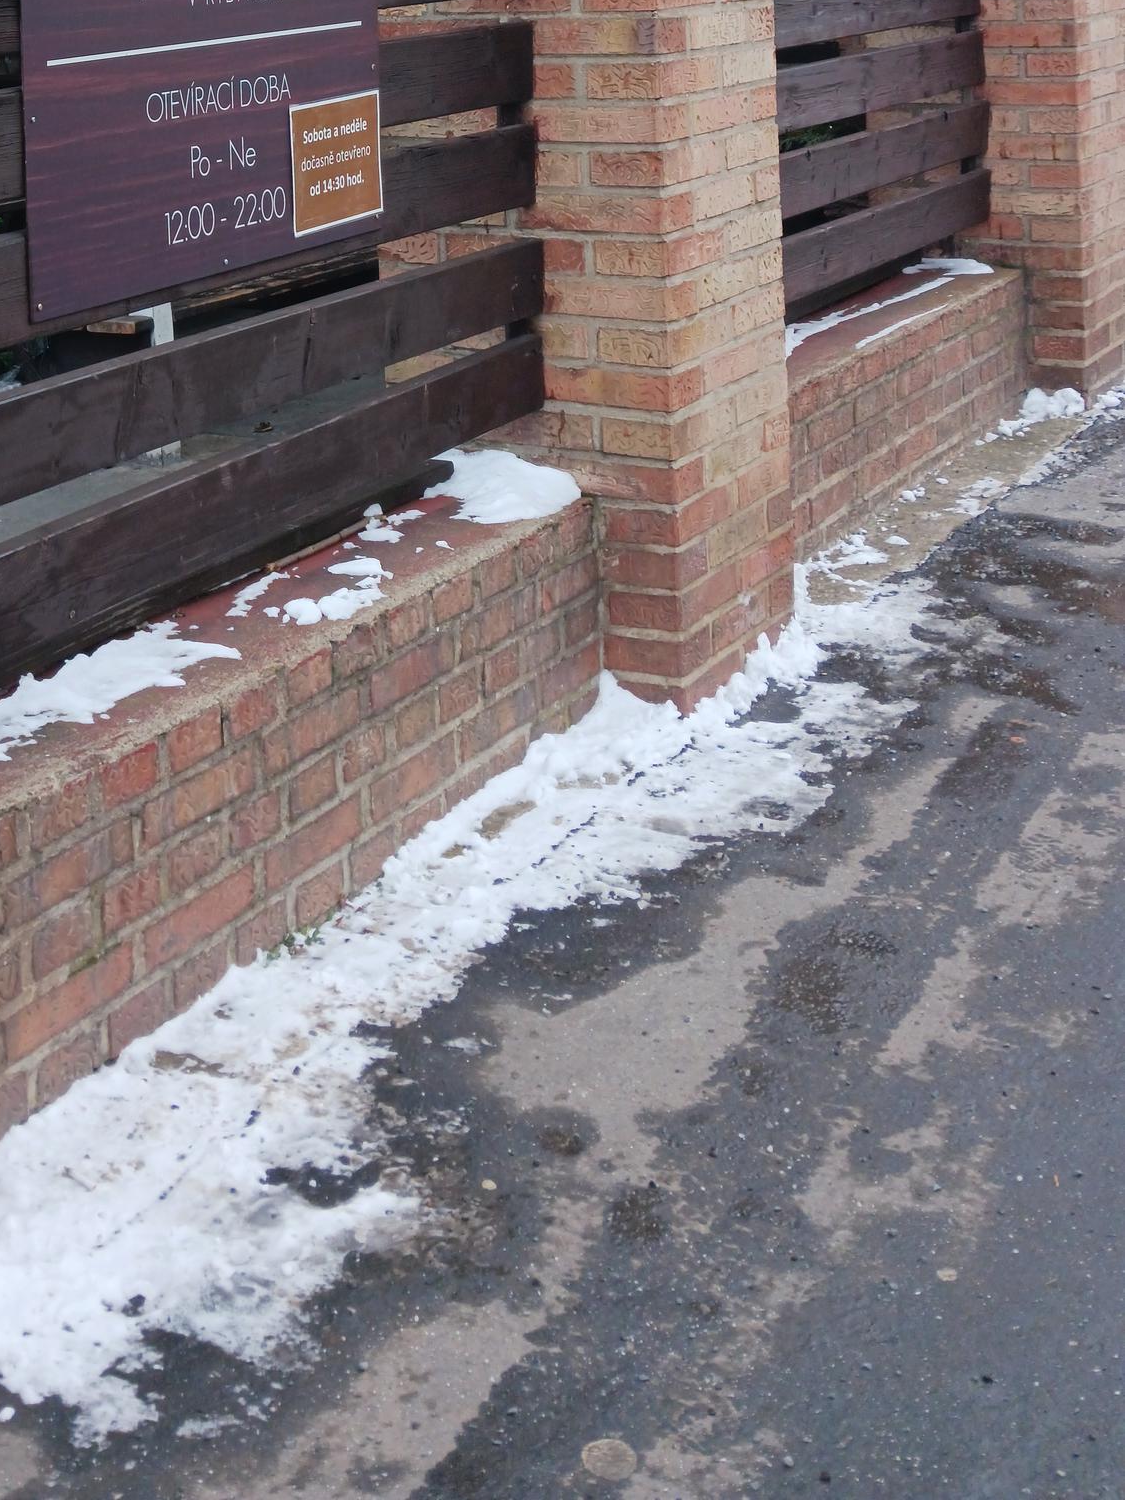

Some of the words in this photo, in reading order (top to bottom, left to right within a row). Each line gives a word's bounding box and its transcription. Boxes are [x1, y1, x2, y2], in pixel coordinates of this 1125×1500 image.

[146, 76, 235, 123] OTEVÍRACÍ
[239, 73, 291, 108] DOBA
[302, 126, 332, 145] Sobota
[333, 128, 339, 138] a
[340, 118, 368, 136] neděle
[190, 144, 211, 179] Po
[229, 136, 256, 170] Ne
[301, 151, 334, 172] dočasně
[336, 143, 371, 165] otevřeno
[309, 182, 321, 197] od
[322, 176, 345, 193] 14:30
[346, 170, 365, 187] hod.
[165, 202, 215, 245] 12:00
[233, 186, 286, 229] 22:00
